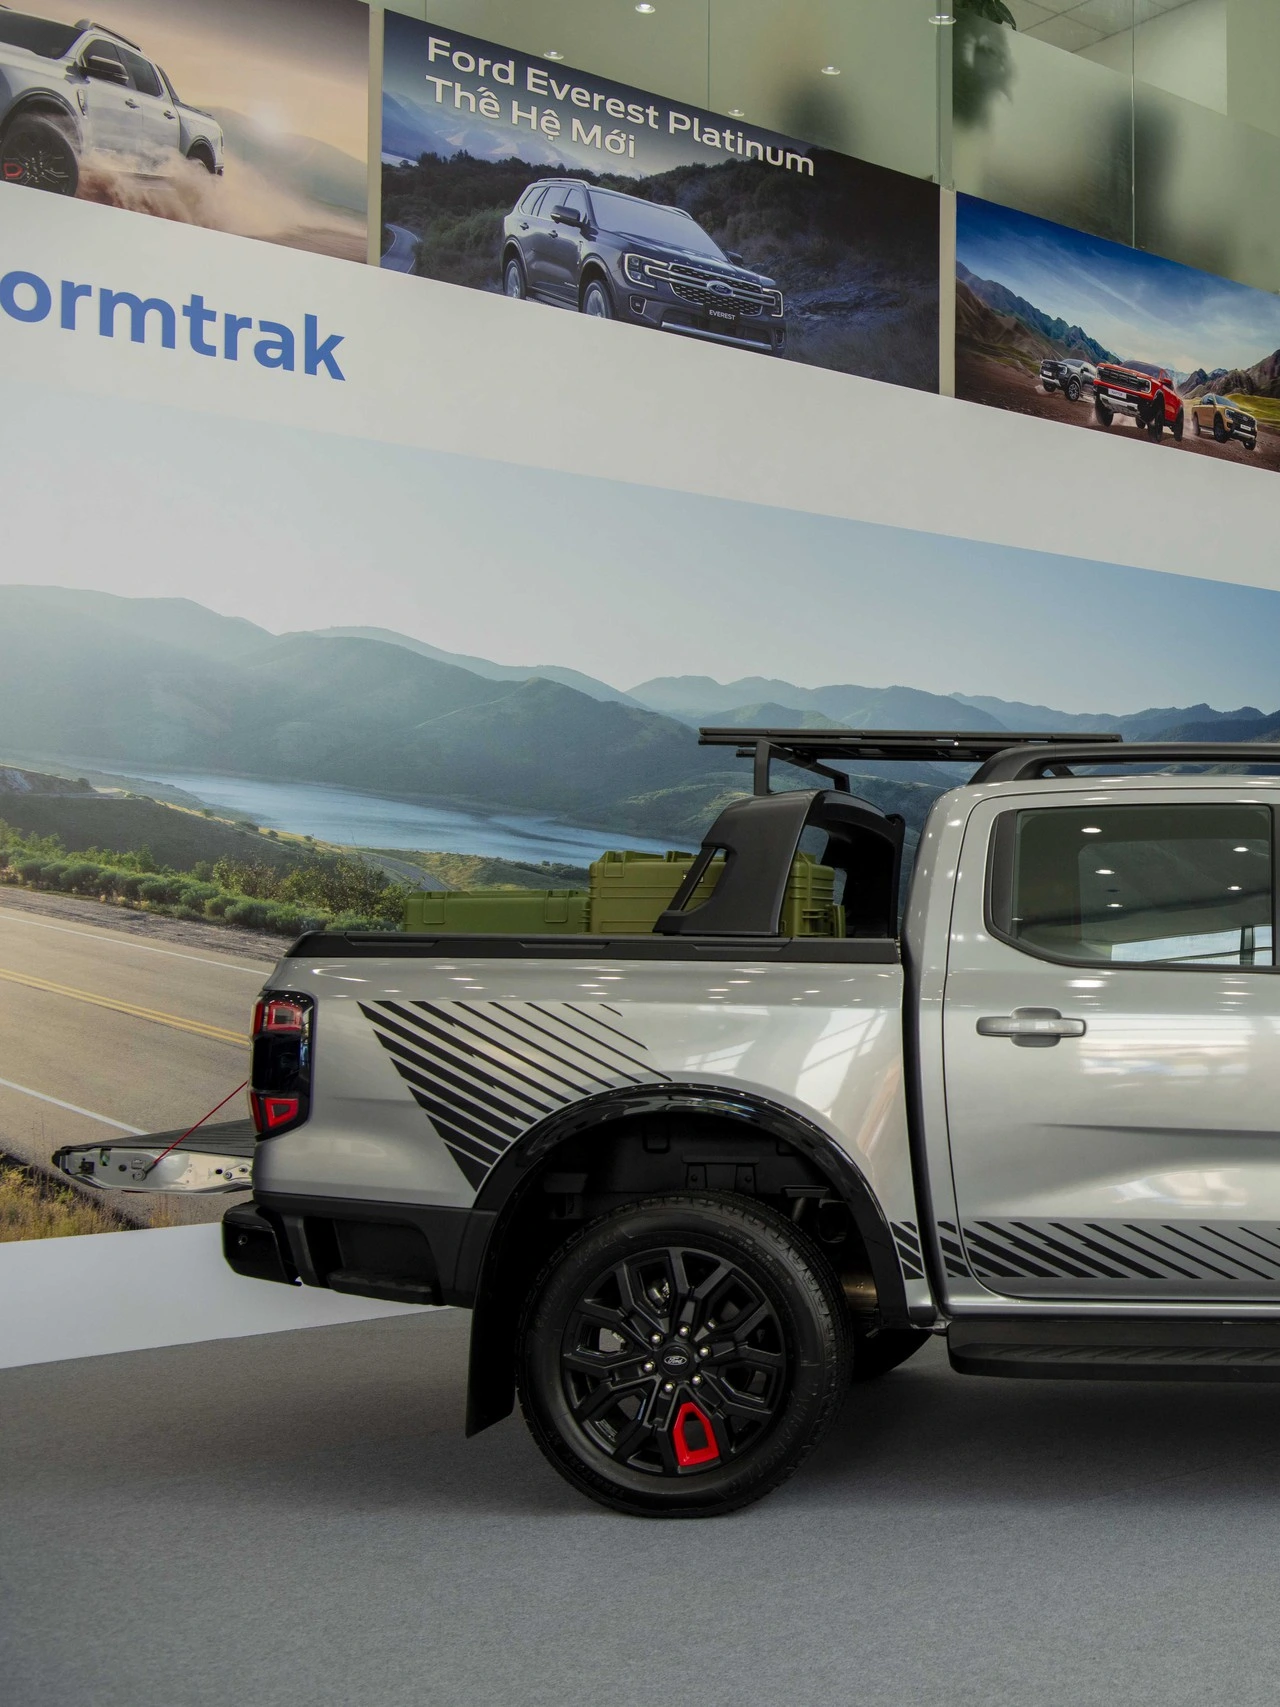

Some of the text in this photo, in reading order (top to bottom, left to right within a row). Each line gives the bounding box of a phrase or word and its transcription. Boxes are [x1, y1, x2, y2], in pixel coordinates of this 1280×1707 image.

[425, 75, 635, 159] Thế Hệ Mới
[428, 36, 814, 177] Ford Everest Platinum
[709, 309, 736, 321] EVEREST
